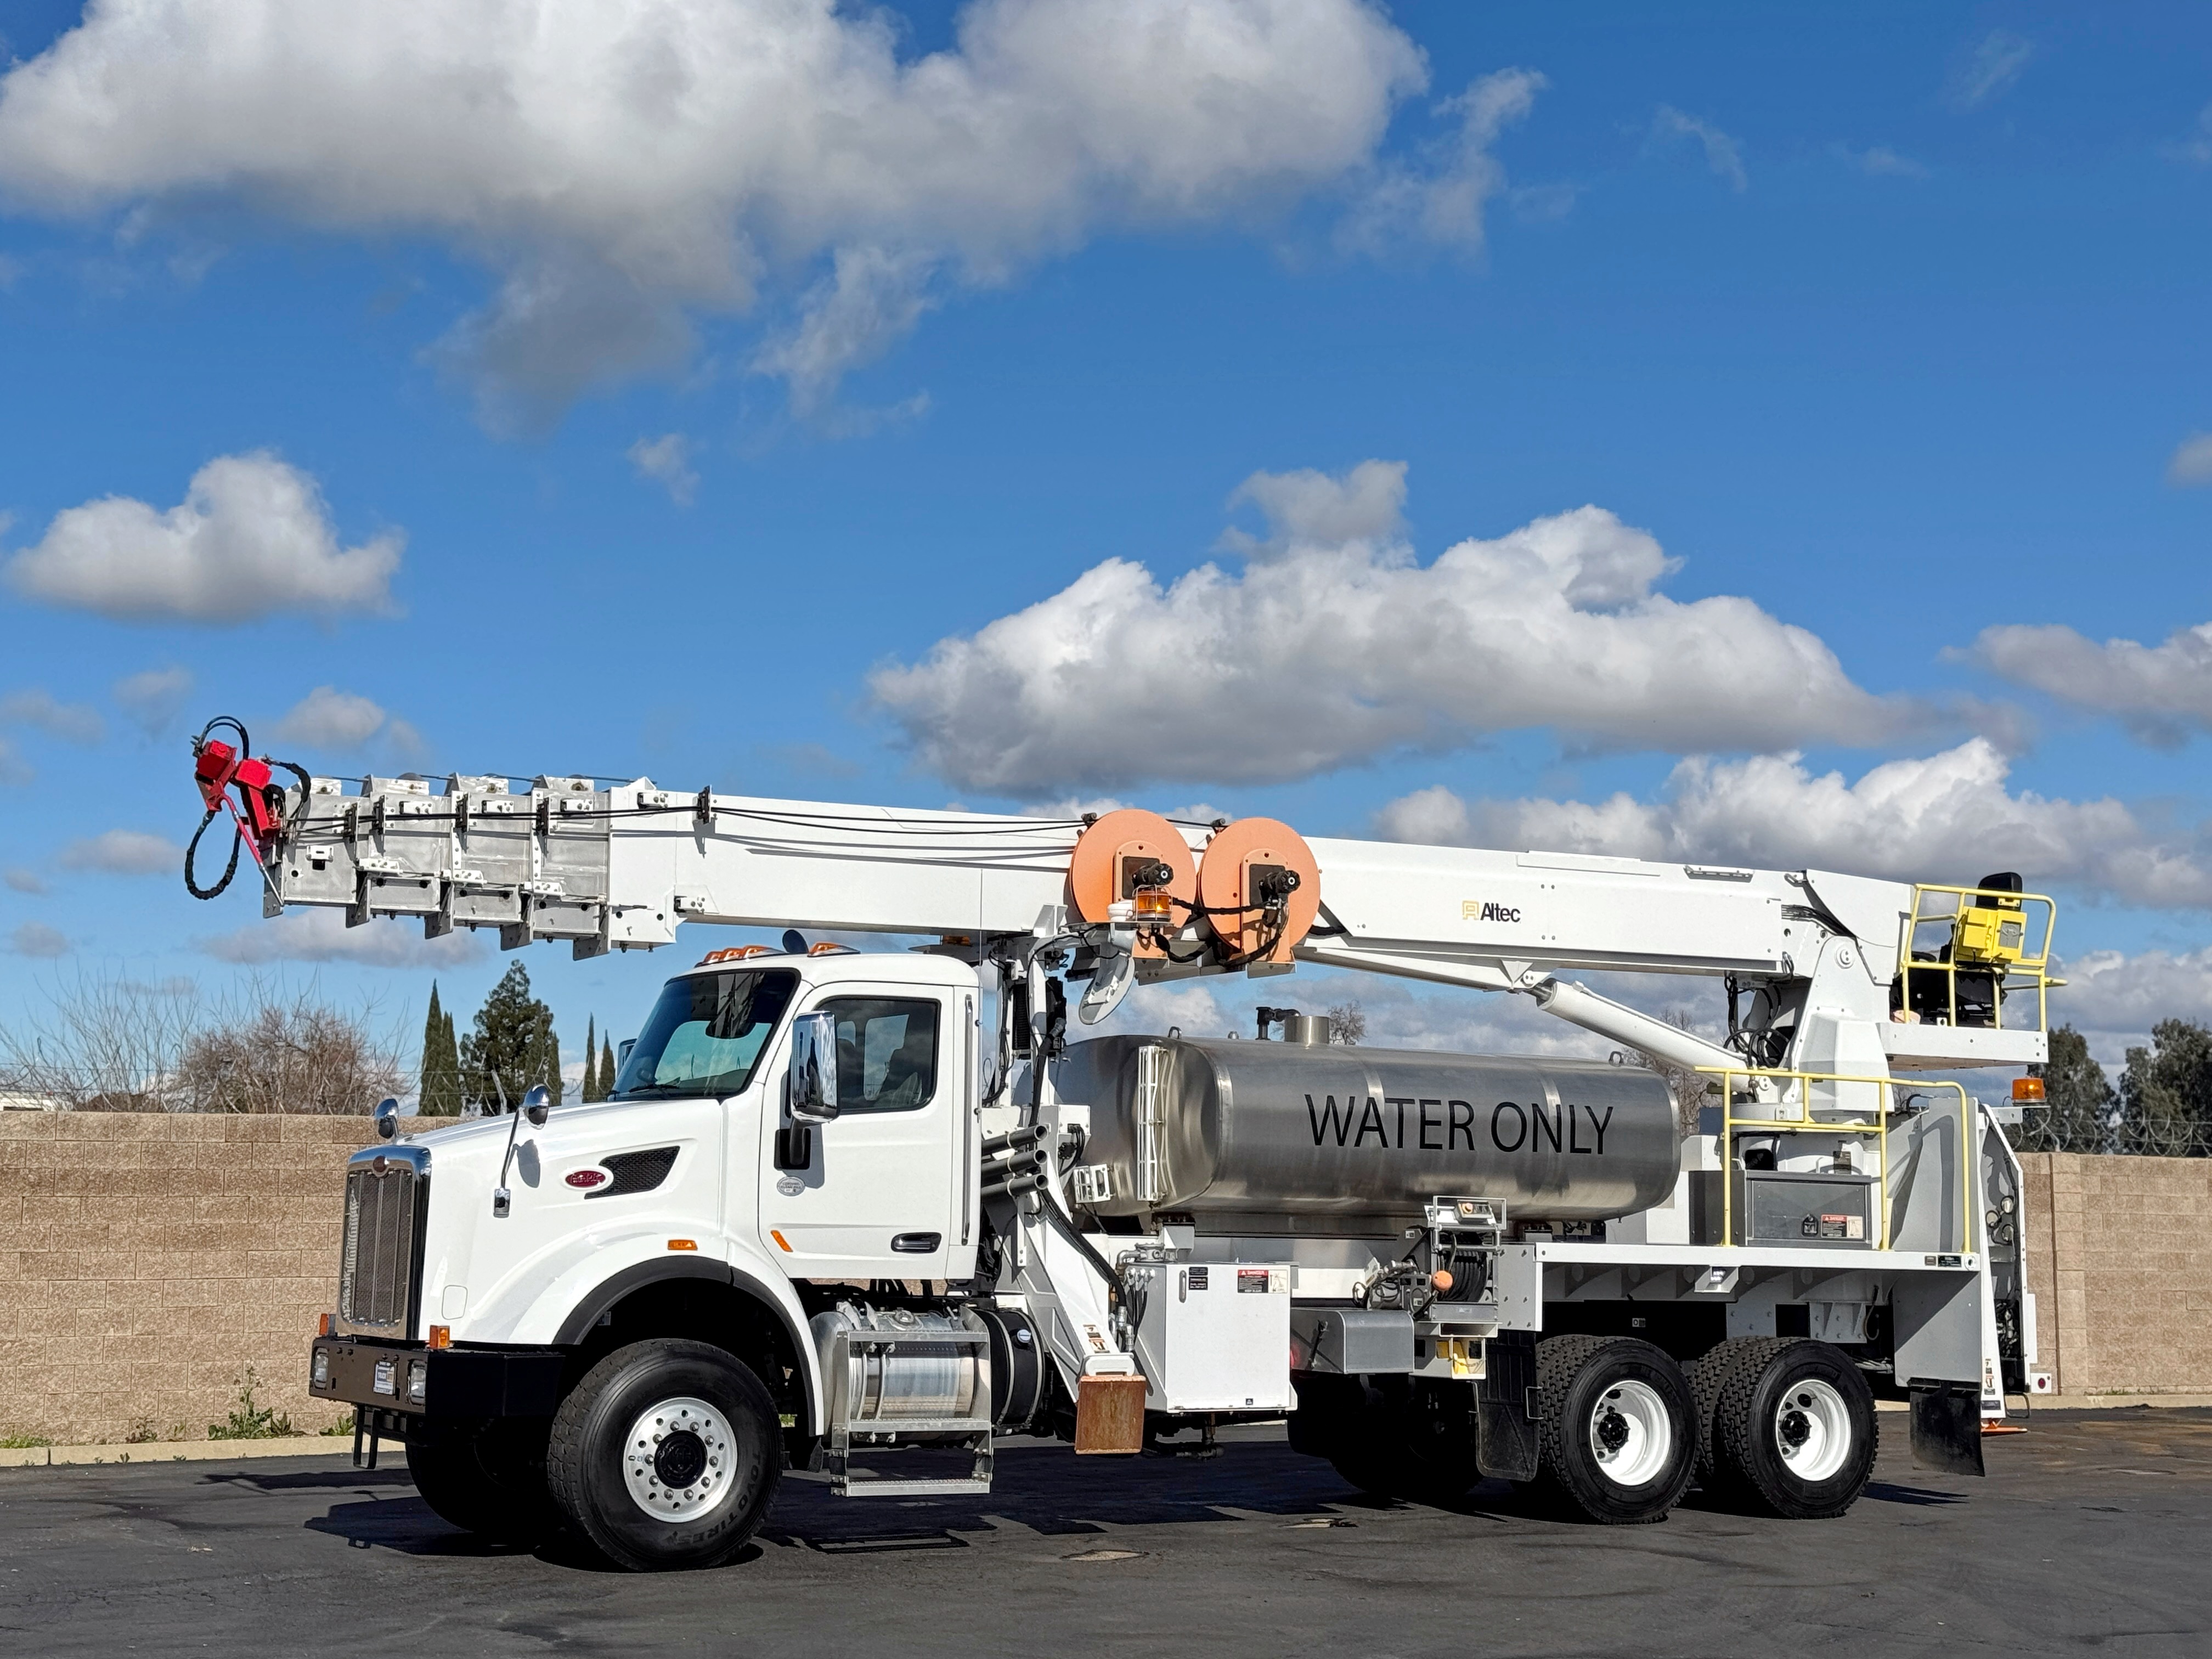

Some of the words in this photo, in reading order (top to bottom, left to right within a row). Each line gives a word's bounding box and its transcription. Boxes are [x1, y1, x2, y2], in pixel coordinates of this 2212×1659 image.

[1480, 902, 1521, 923] Altec
[1304, 1094, 1475, 1151] WATER
[1491, 1102, 1613, 1155] ONLY
[738, 1452, 761, 1511] TOYO
[677, 1512, 738, 1544] TIRES
